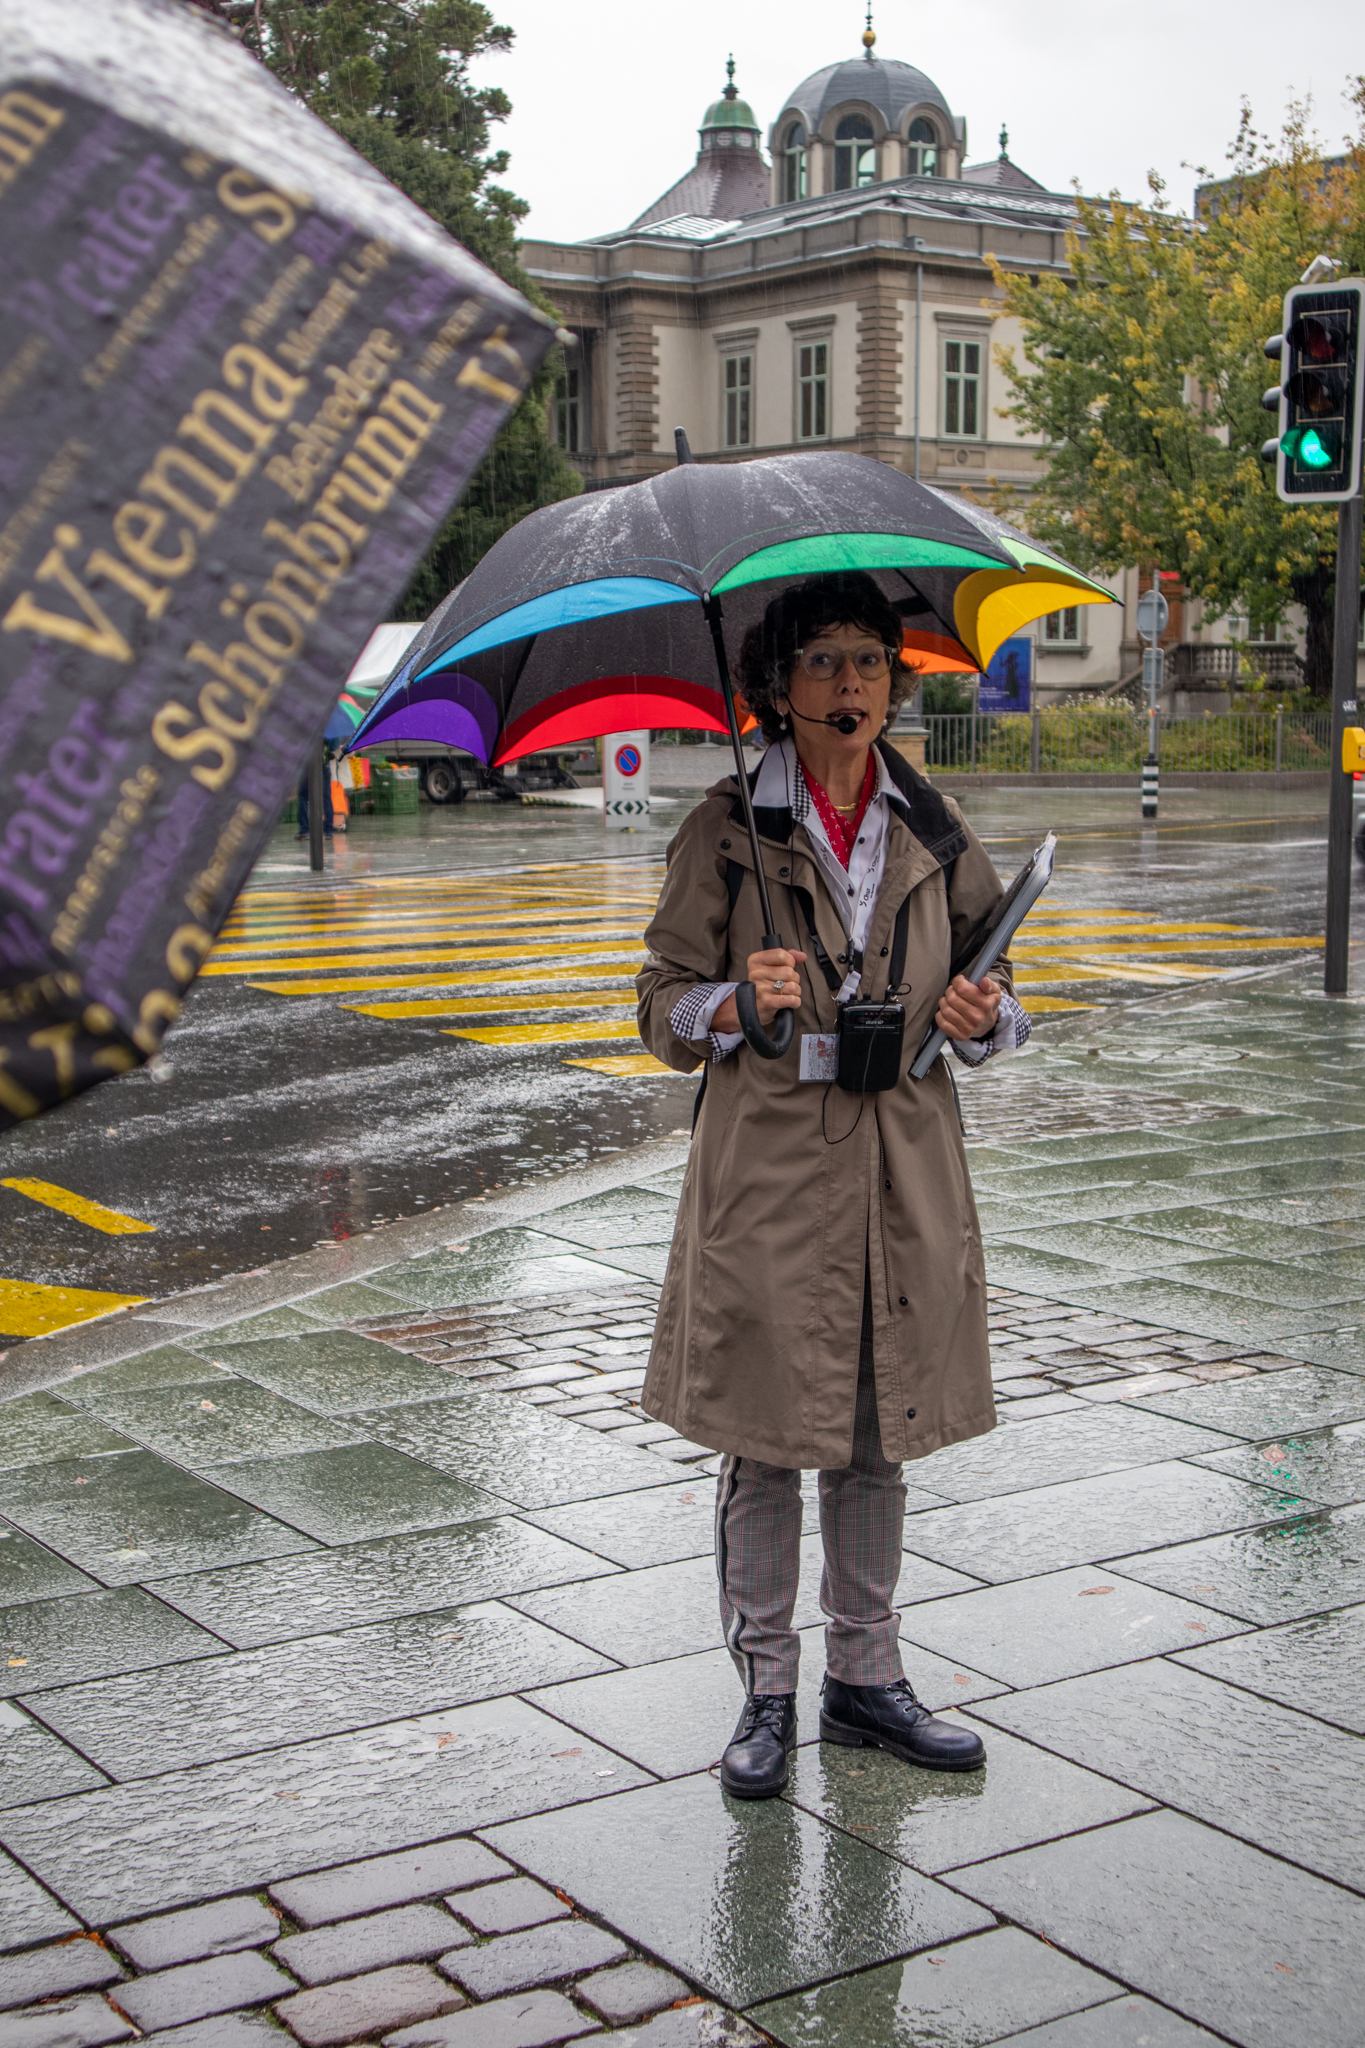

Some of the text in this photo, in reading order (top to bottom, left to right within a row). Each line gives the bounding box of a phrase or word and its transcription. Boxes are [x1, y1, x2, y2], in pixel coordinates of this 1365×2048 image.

[3, 343, 309, 662] Vienna
[264, 328, 402, 502] Belvedere
[152, 378, 444, 790] Schönbrunn
